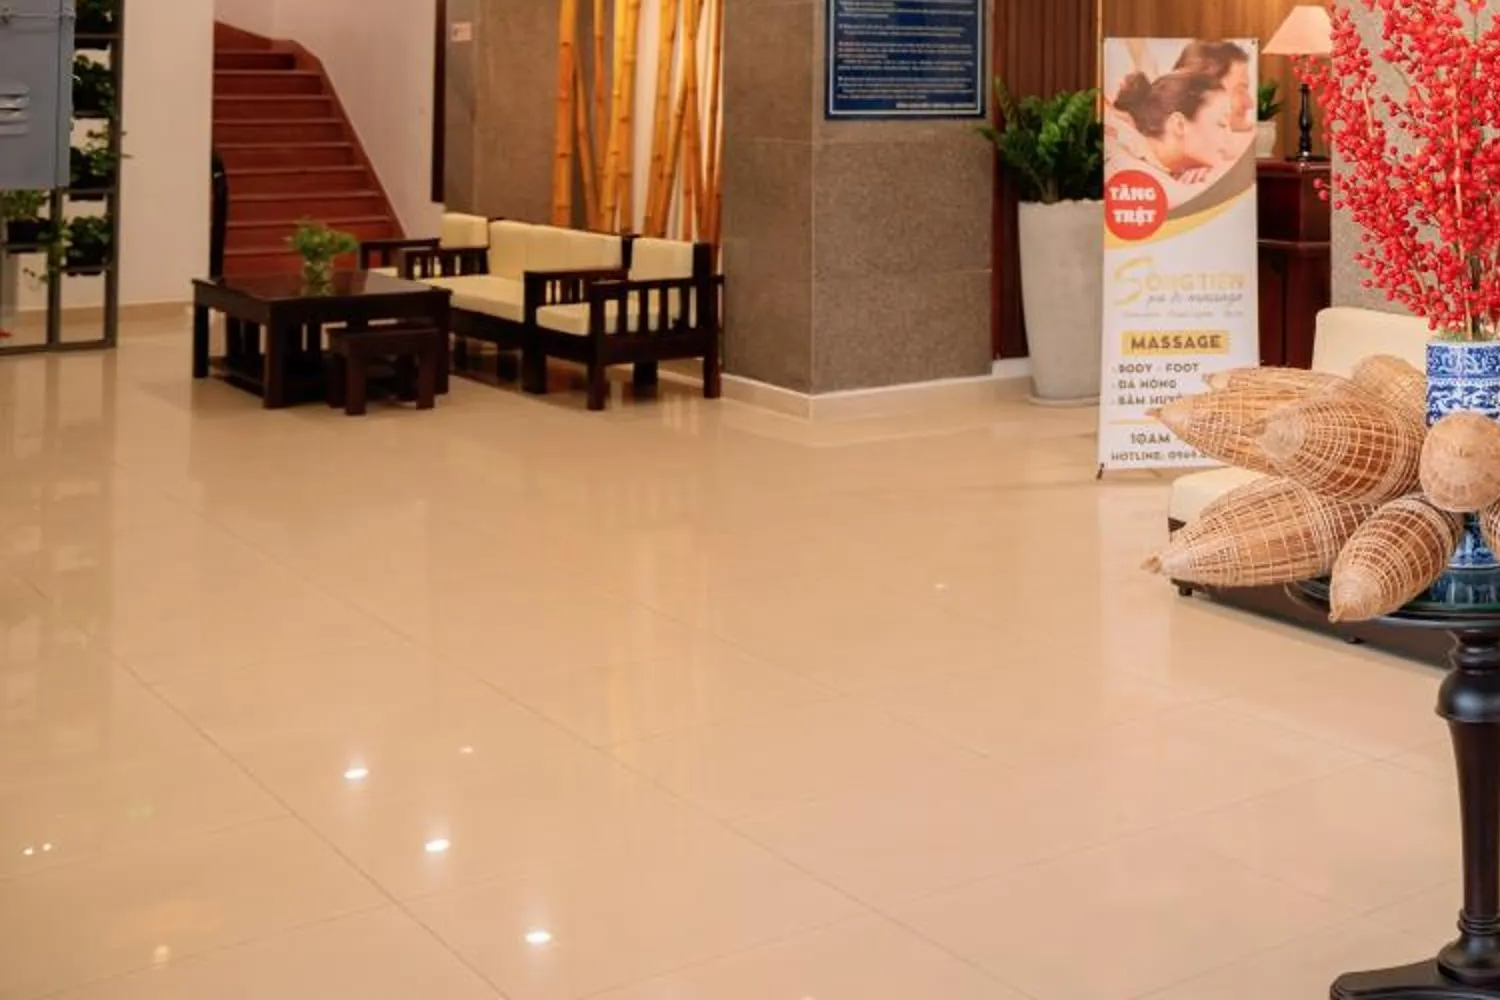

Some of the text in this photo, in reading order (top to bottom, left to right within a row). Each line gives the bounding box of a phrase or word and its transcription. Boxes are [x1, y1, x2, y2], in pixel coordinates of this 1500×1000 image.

[1130, 334, 1223, 350] MASSAGE
[1118, 361, 1200, 373] BODY FOOT
[1130, 432, 1171, 445] 10AM
